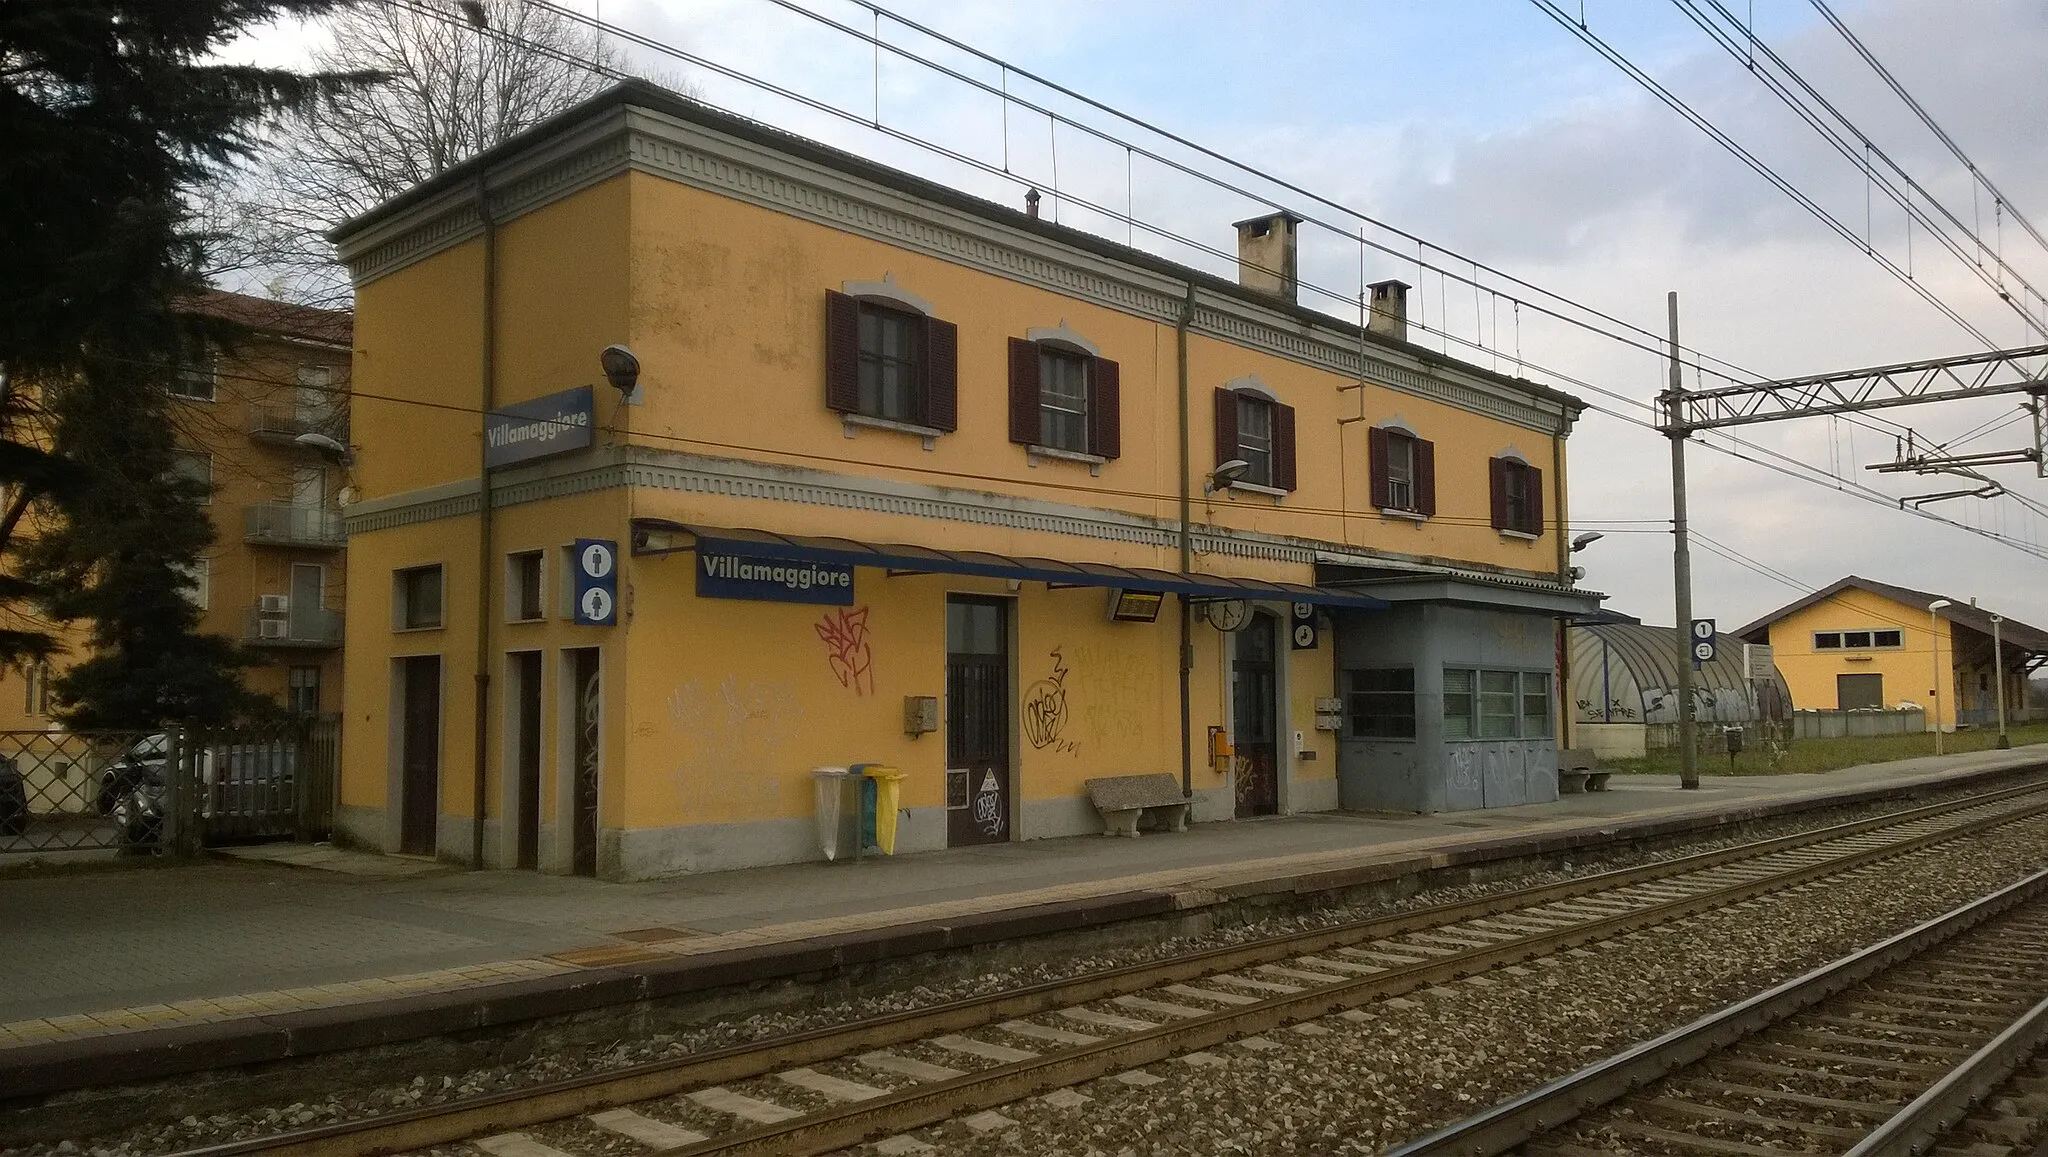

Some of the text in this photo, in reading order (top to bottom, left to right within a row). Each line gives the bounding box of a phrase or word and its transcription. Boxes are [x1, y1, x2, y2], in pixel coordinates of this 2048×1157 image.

[488, 411, 587, 448] Villamaggiore
[703, 556, 850, 589] Villamaggiore
[1700, 624, 1707, 636] 1
